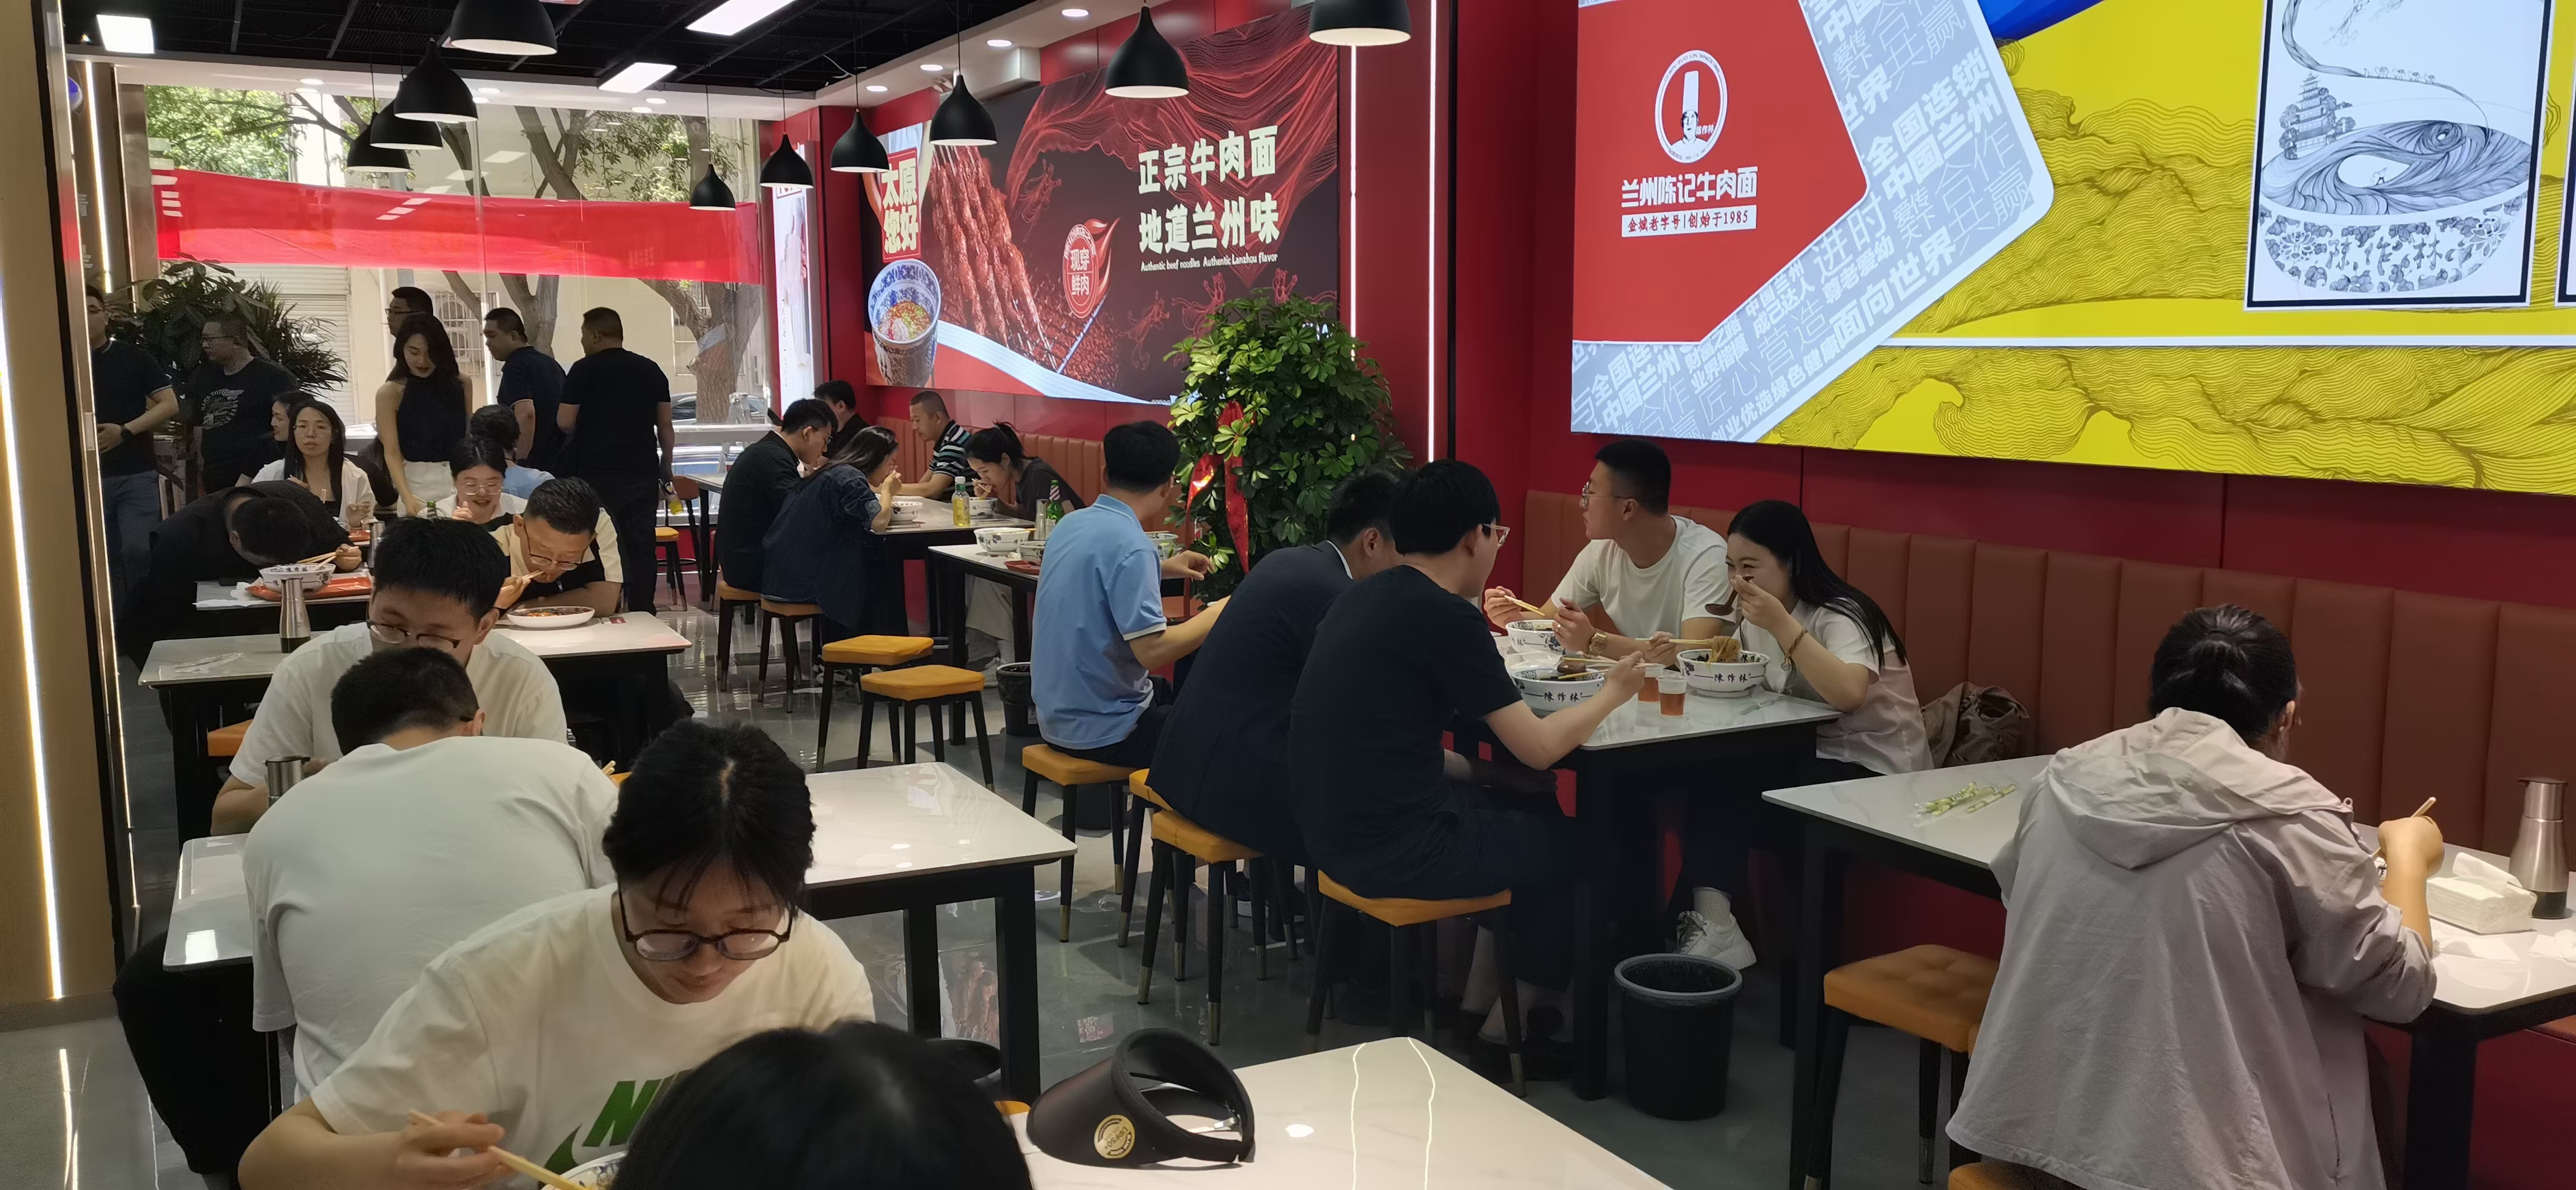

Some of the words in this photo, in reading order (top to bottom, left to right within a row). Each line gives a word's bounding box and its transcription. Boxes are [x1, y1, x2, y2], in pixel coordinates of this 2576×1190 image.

[1867, 47, 1990, 177] 全国连锁
[1882, 82, 2002, 200] 中国兰州
[1138, 125, 1278, 195] 正宗牛肉面
[1621, 166, 1758, 207] 兰州陈记牛肉面
[1935, 122, 2015, 214] 合作
[884, 204, 918, 254] 您好
[1139, 192, 1280, 254] 地道兰州味
[2326, 232, 2444, 276] 陈作林
[1140, 260, 1166, 272] Authentic
[1166, 259, 1179, 271] beef
[1180, 257, 1201, 269] noodles
[1202, 254, 1232, 267] Authentic
[1232, 252, 1257, 265] Lanzhou
[1258, 251, 1278, 265] flavor
[1821, 235, 1895, 304] 尊老爱幼
[1829, 225, 1957, 349] 面向世界
[1591, 344, 1664, 407] 全国连
[1602, 344, 1681, 428] 中国兰州
